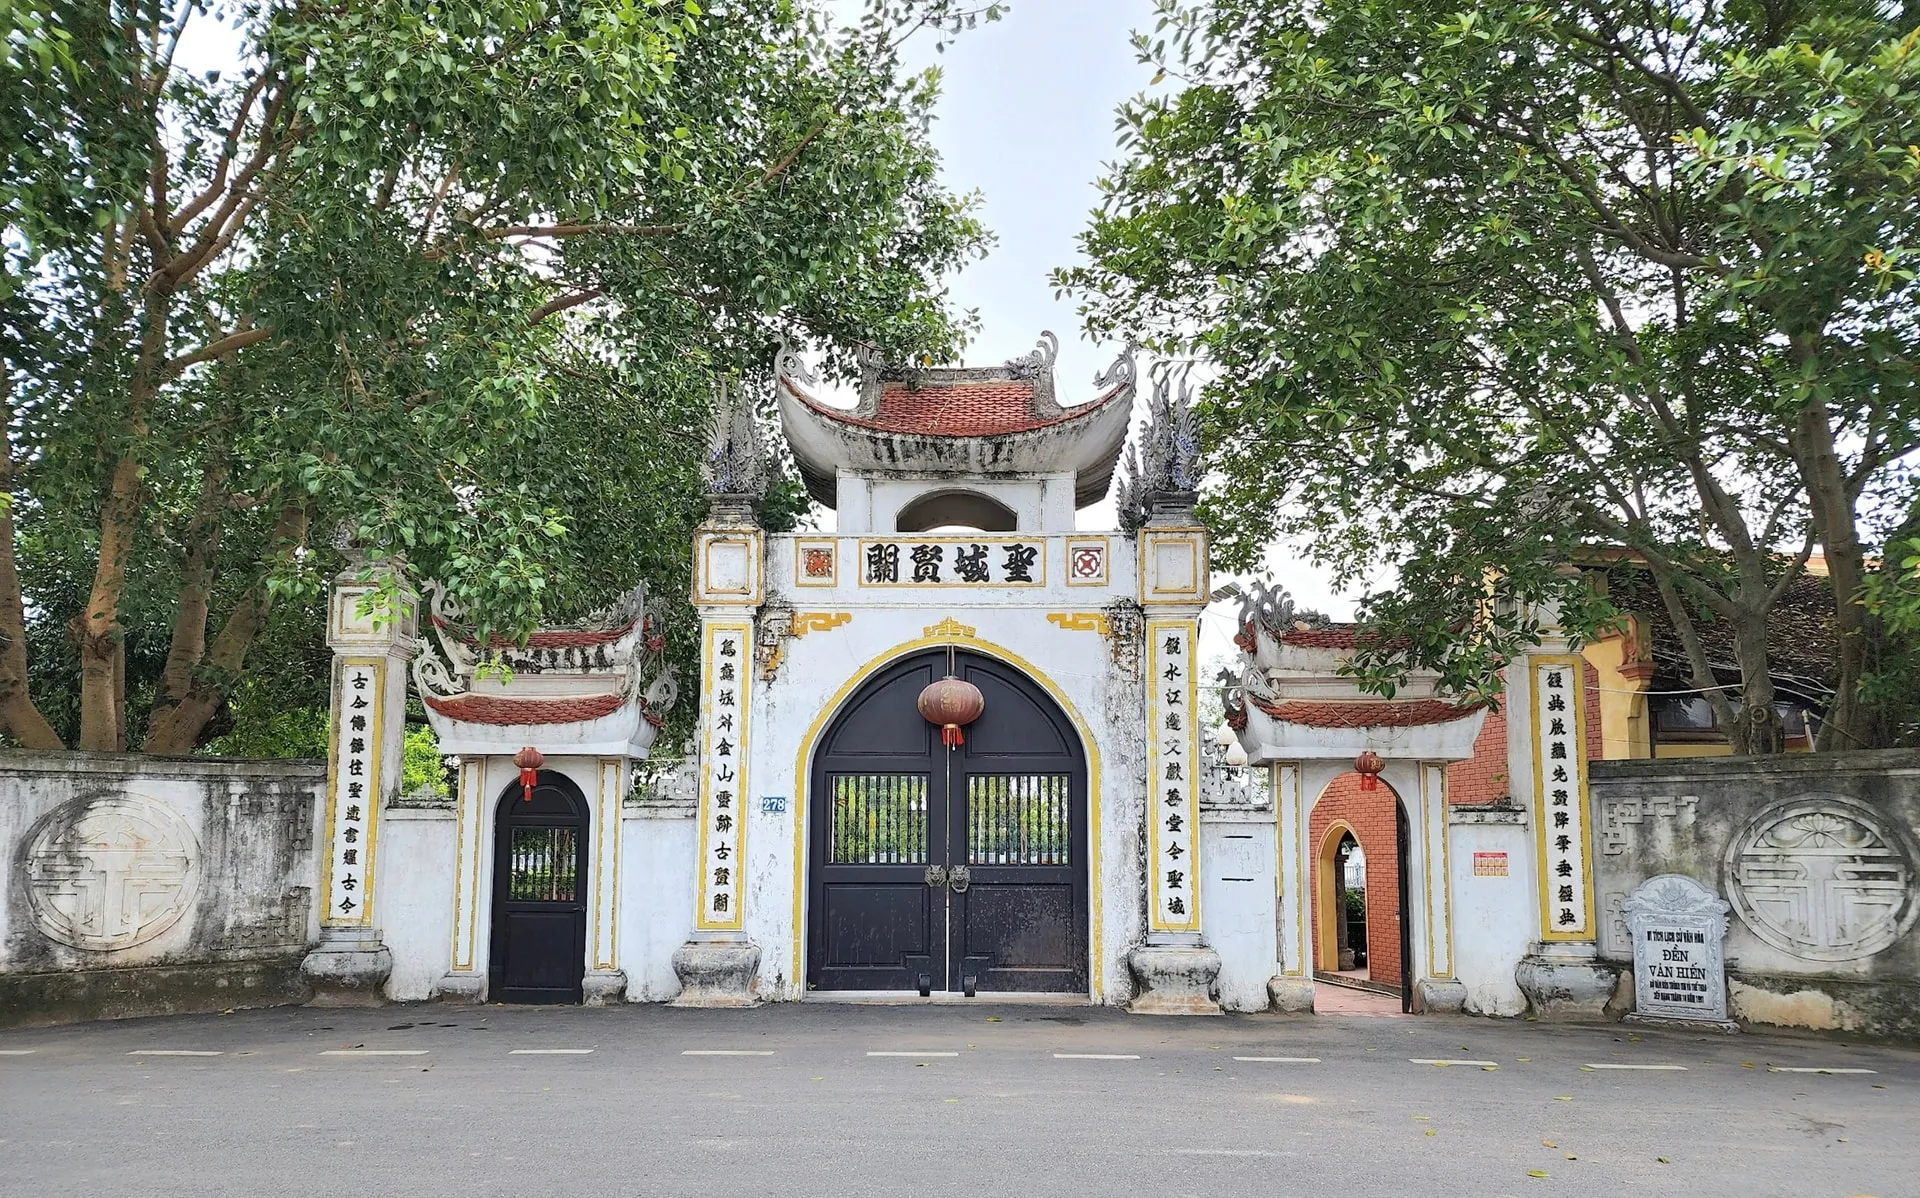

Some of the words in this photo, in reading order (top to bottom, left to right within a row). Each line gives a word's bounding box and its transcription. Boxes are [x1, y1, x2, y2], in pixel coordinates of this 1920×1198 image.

[763, 798, 785, 811] 278
[1662, 944, 1689, 962] ĐỀN
[1676, 962, 1706, 980] HIẾN
